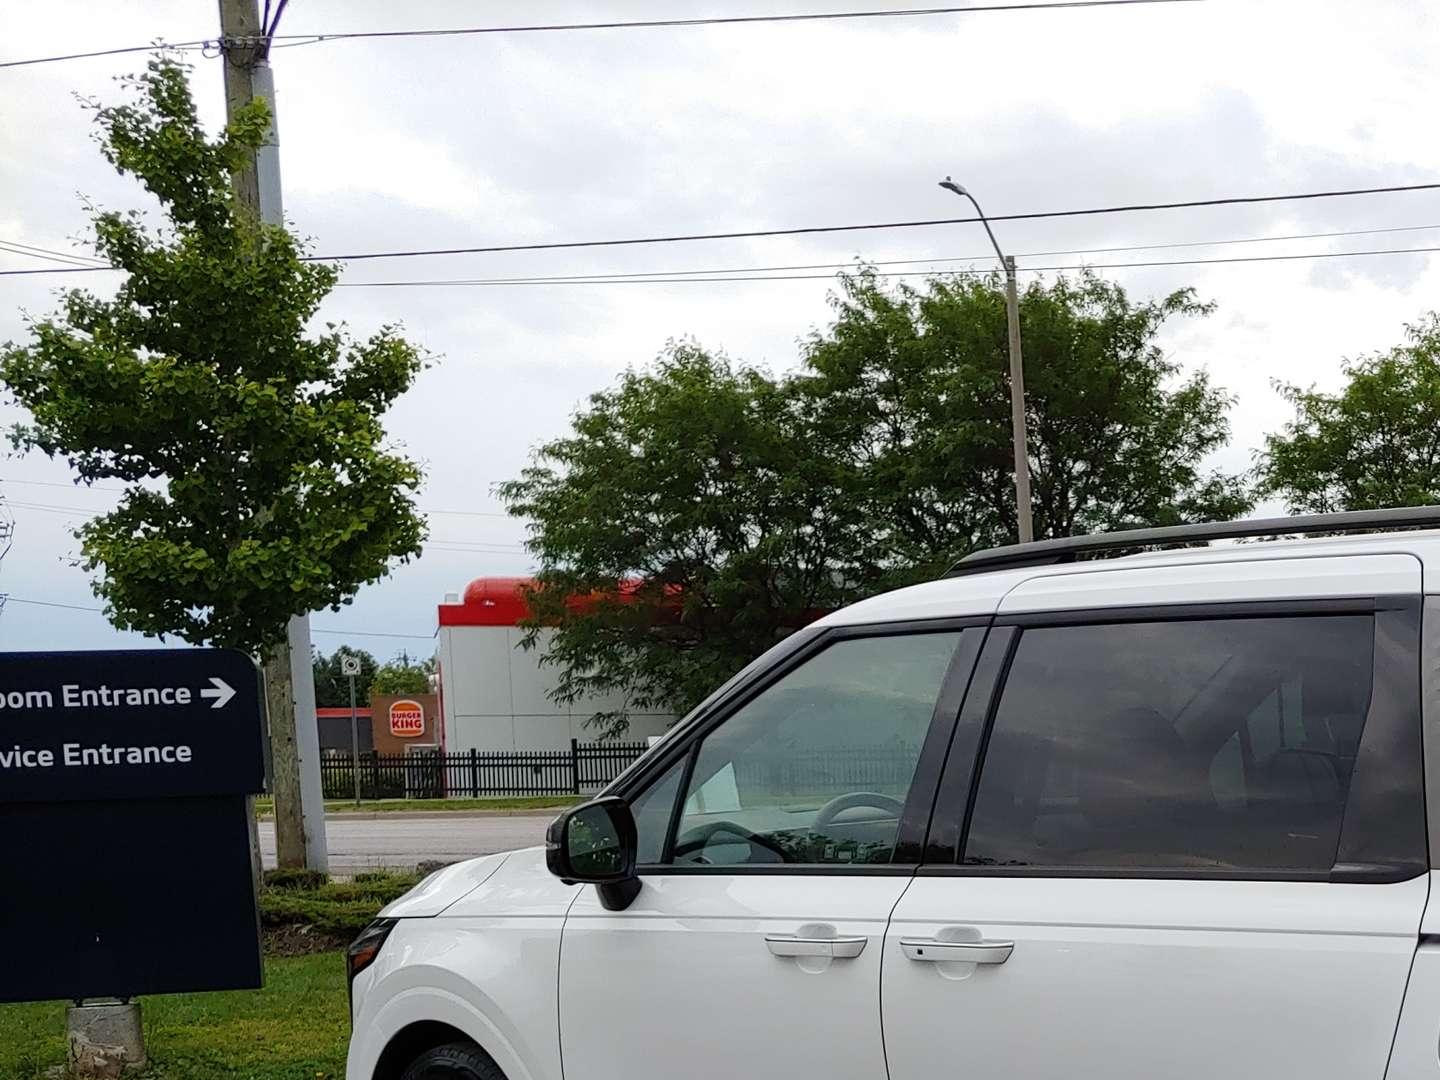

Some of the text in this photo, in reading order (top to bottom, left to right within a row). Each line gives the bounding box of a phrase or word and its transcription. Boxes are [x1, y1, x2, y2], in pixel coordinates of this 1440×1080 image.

[62, 684, 192, 708] Entrance
[391, 719, 422, 729] KING
[63, 743, 192, 766] Entrance
